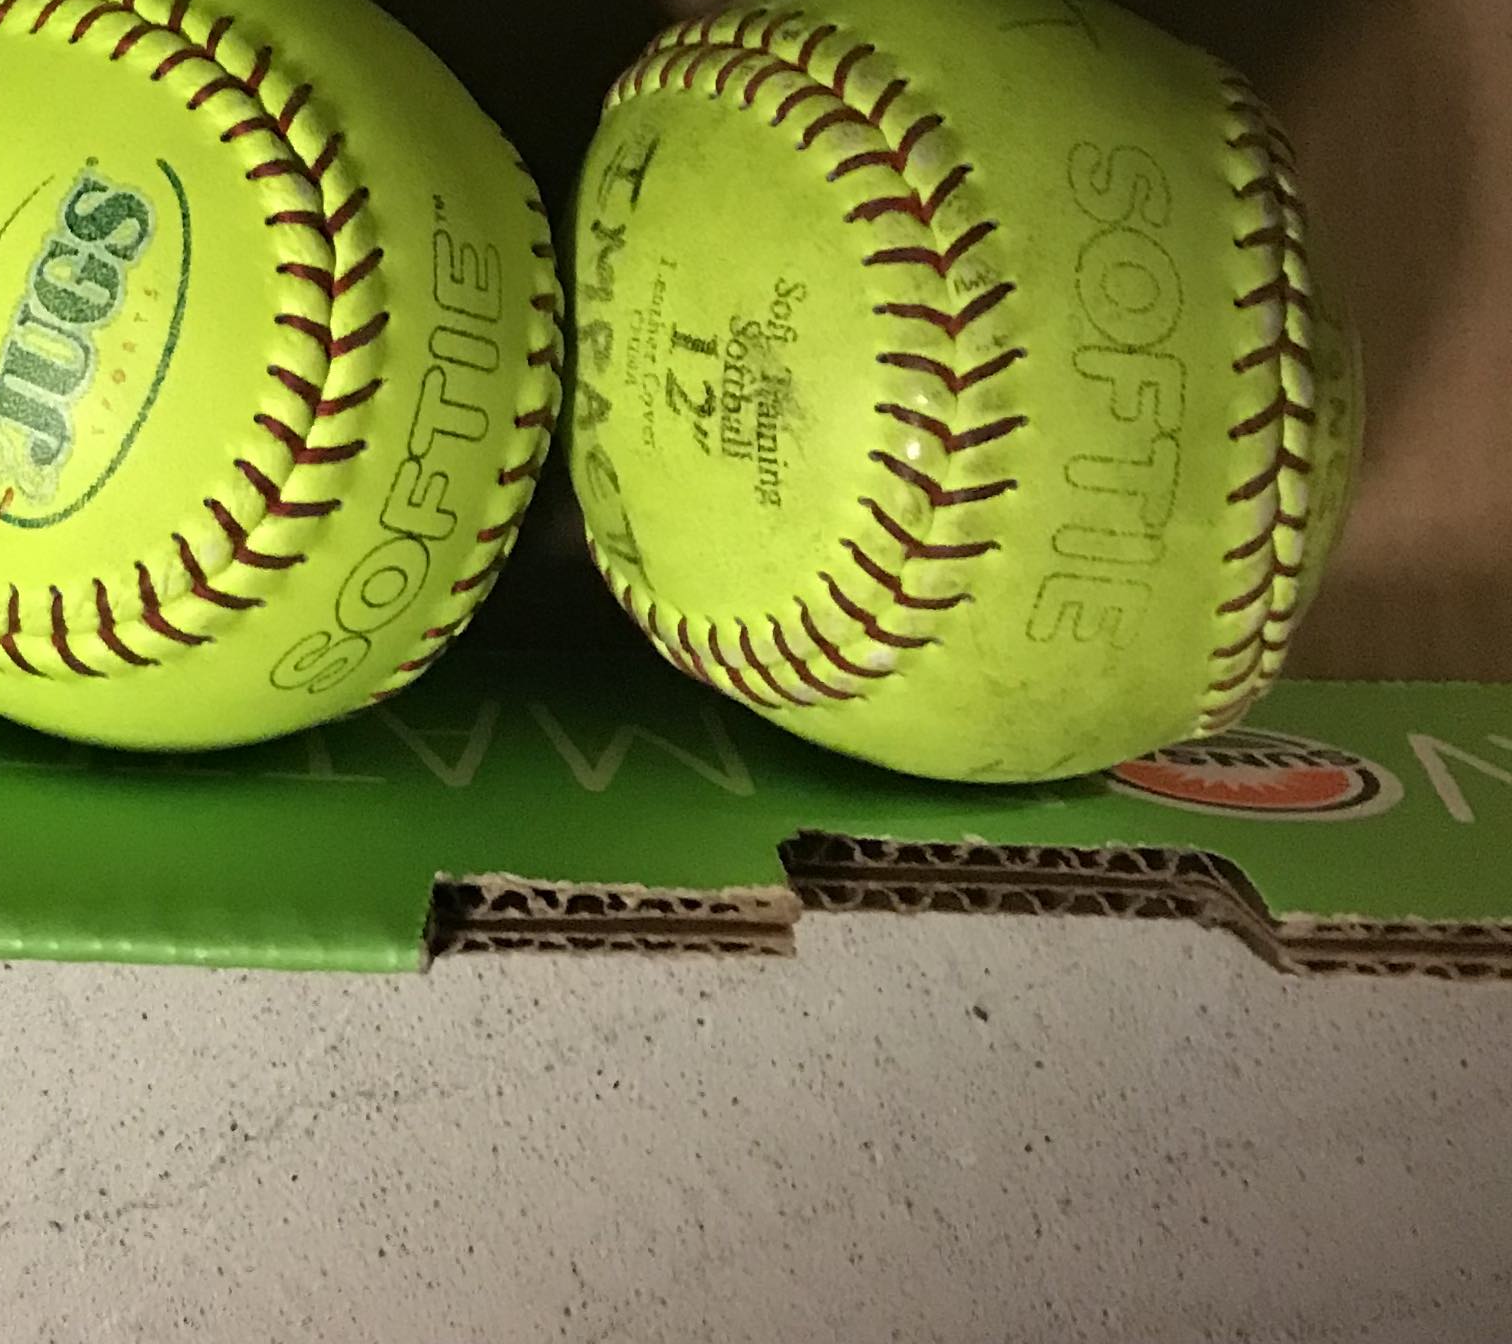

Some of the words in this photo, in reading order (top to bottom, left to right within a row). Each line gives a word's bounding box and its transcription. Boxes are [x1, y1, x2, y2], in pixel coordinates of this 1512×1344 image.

[762, 277, 808, 345] Soft
[269, 228, 500, 694] SOFTIE
[720, 314, 762, 462] Softball
[755, 366, 793, 511] Training
[1025, 139, 1188, 645] SOFTIE
